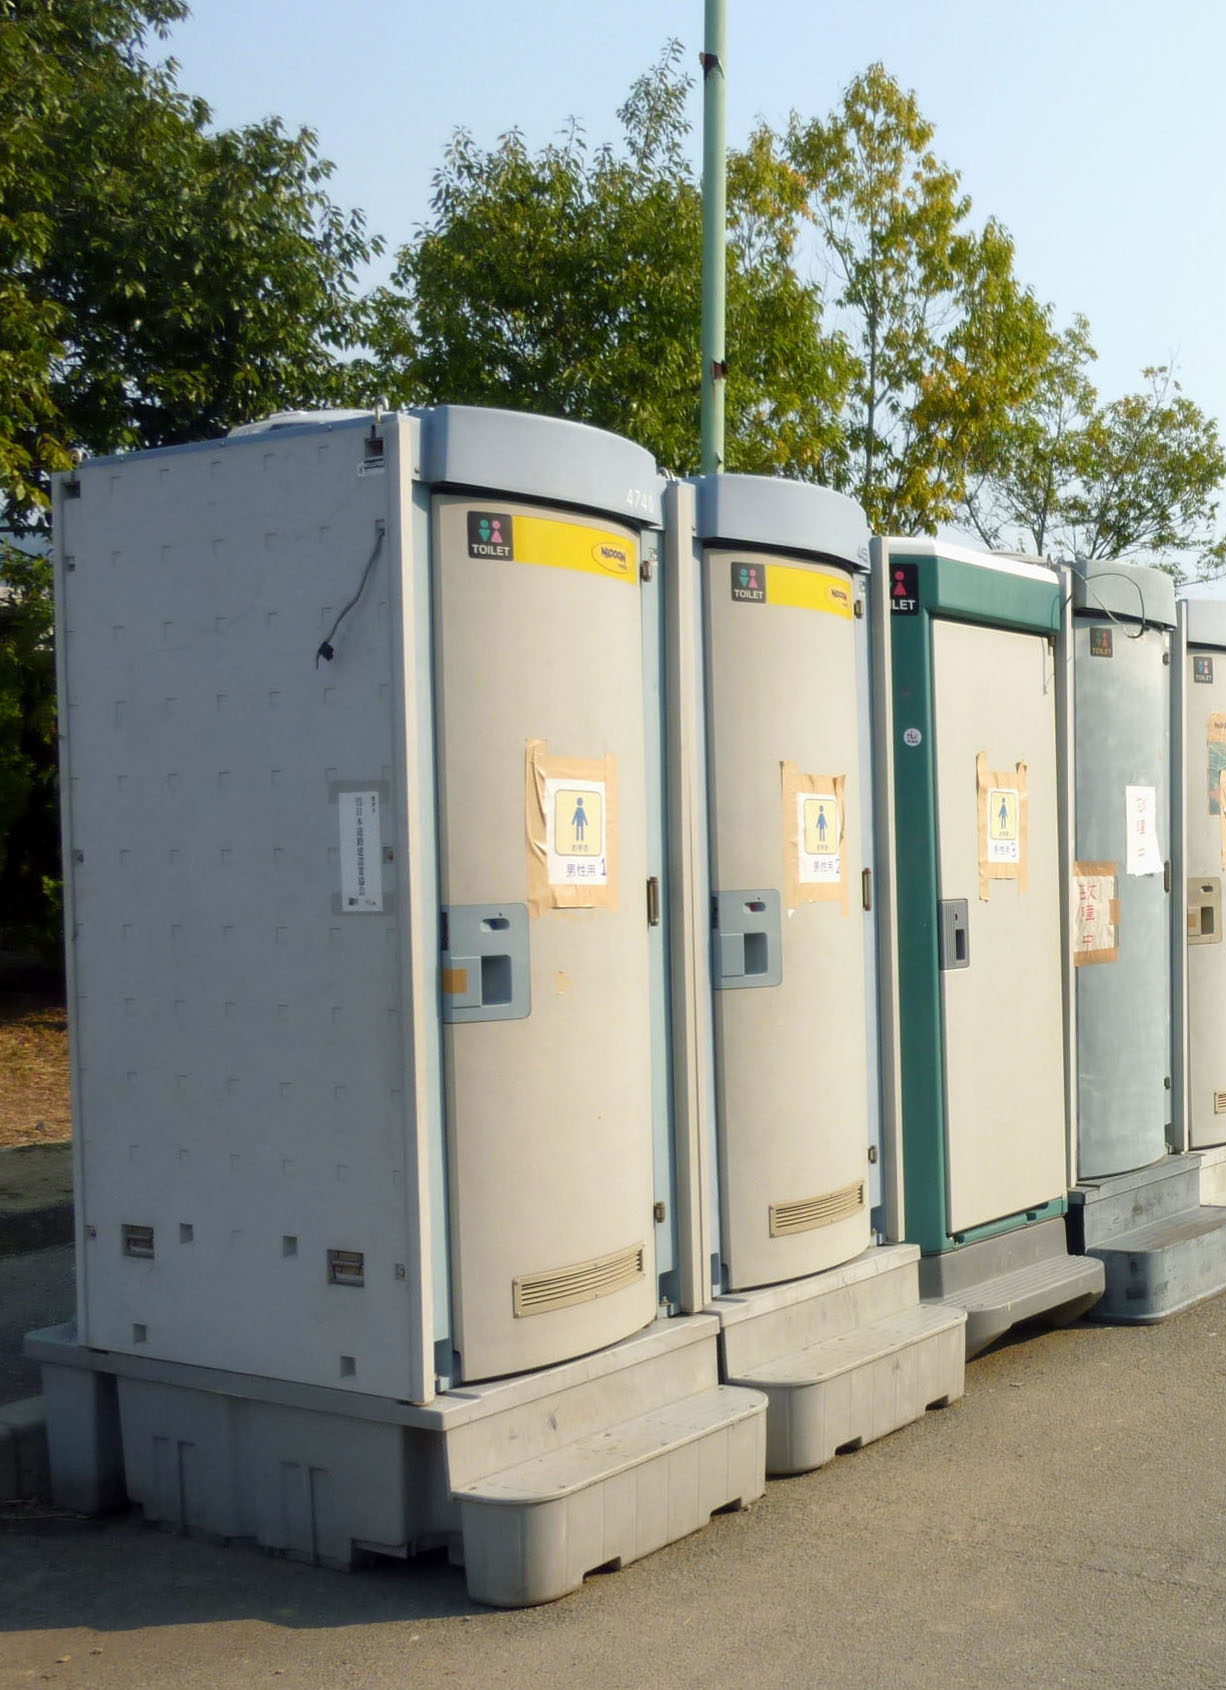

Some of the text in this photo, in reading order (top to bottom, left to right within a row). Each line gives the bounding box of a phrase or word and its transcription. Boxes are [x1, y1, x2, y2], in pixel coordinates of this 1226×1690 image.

[472, 543, 511, 556] TOILET
[734, 588, 764, 599] TOILET
[566, 863, 596, 878] 男性用
